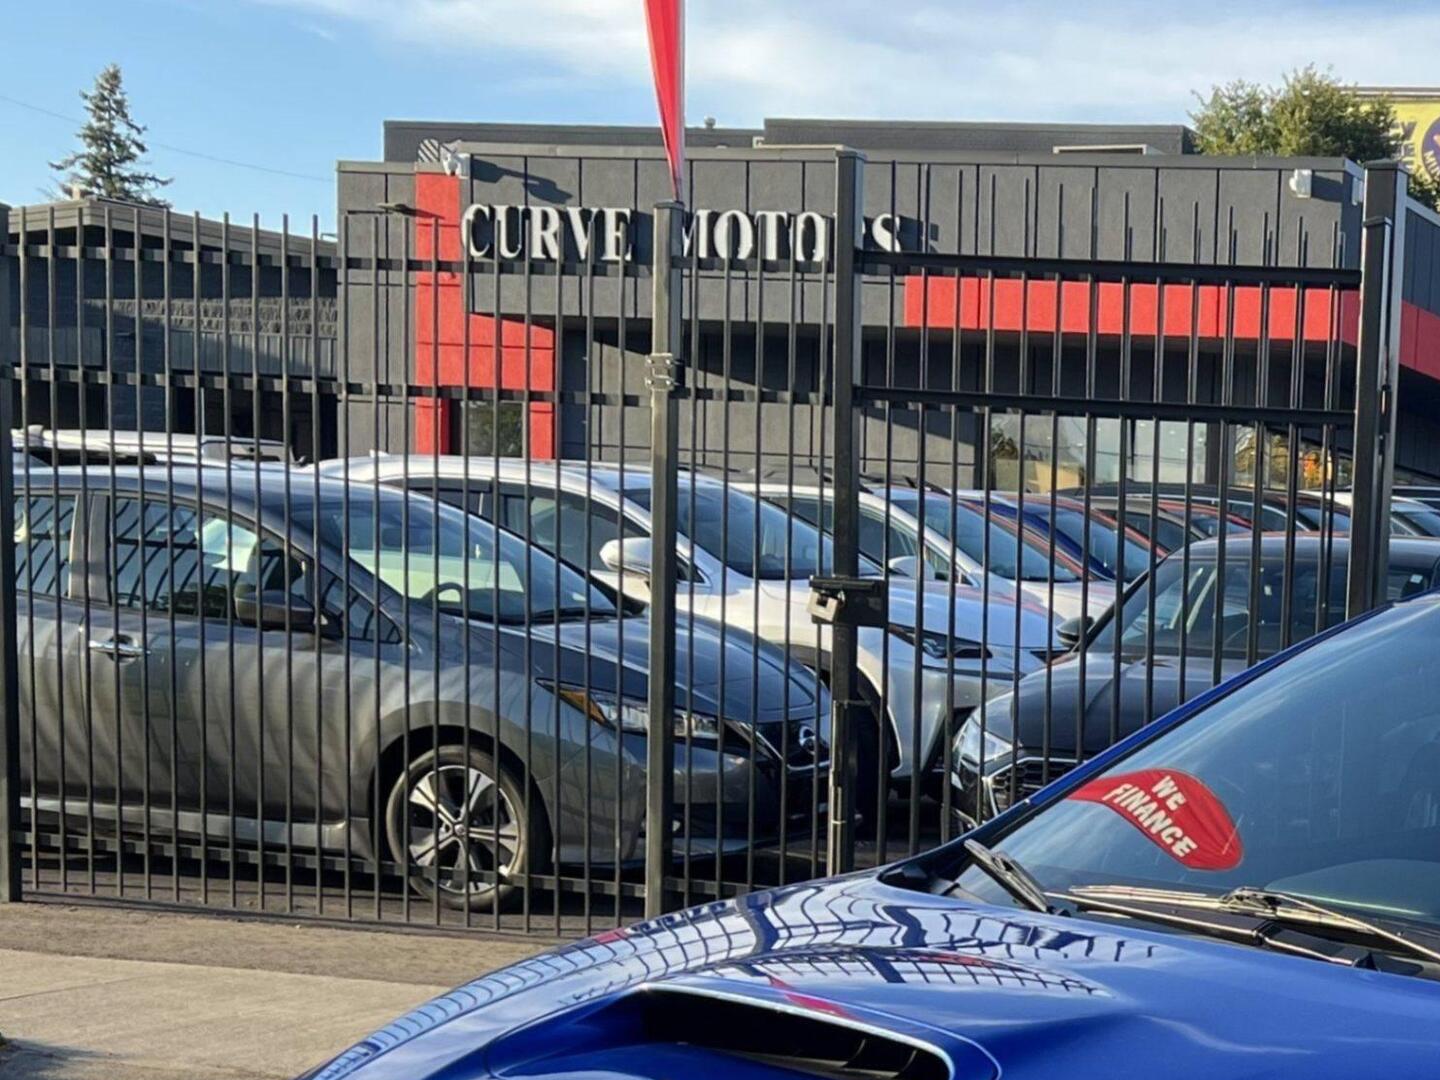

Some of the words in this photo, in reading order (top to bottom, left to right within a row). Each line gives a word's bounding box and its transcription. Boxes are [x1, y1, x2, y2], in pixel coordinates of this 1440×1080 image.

[460, 203, 632, 260] CURVE
[681, 209, 901, 262] MOTOS
[1101, 783, 1199, 858] FINANCE
